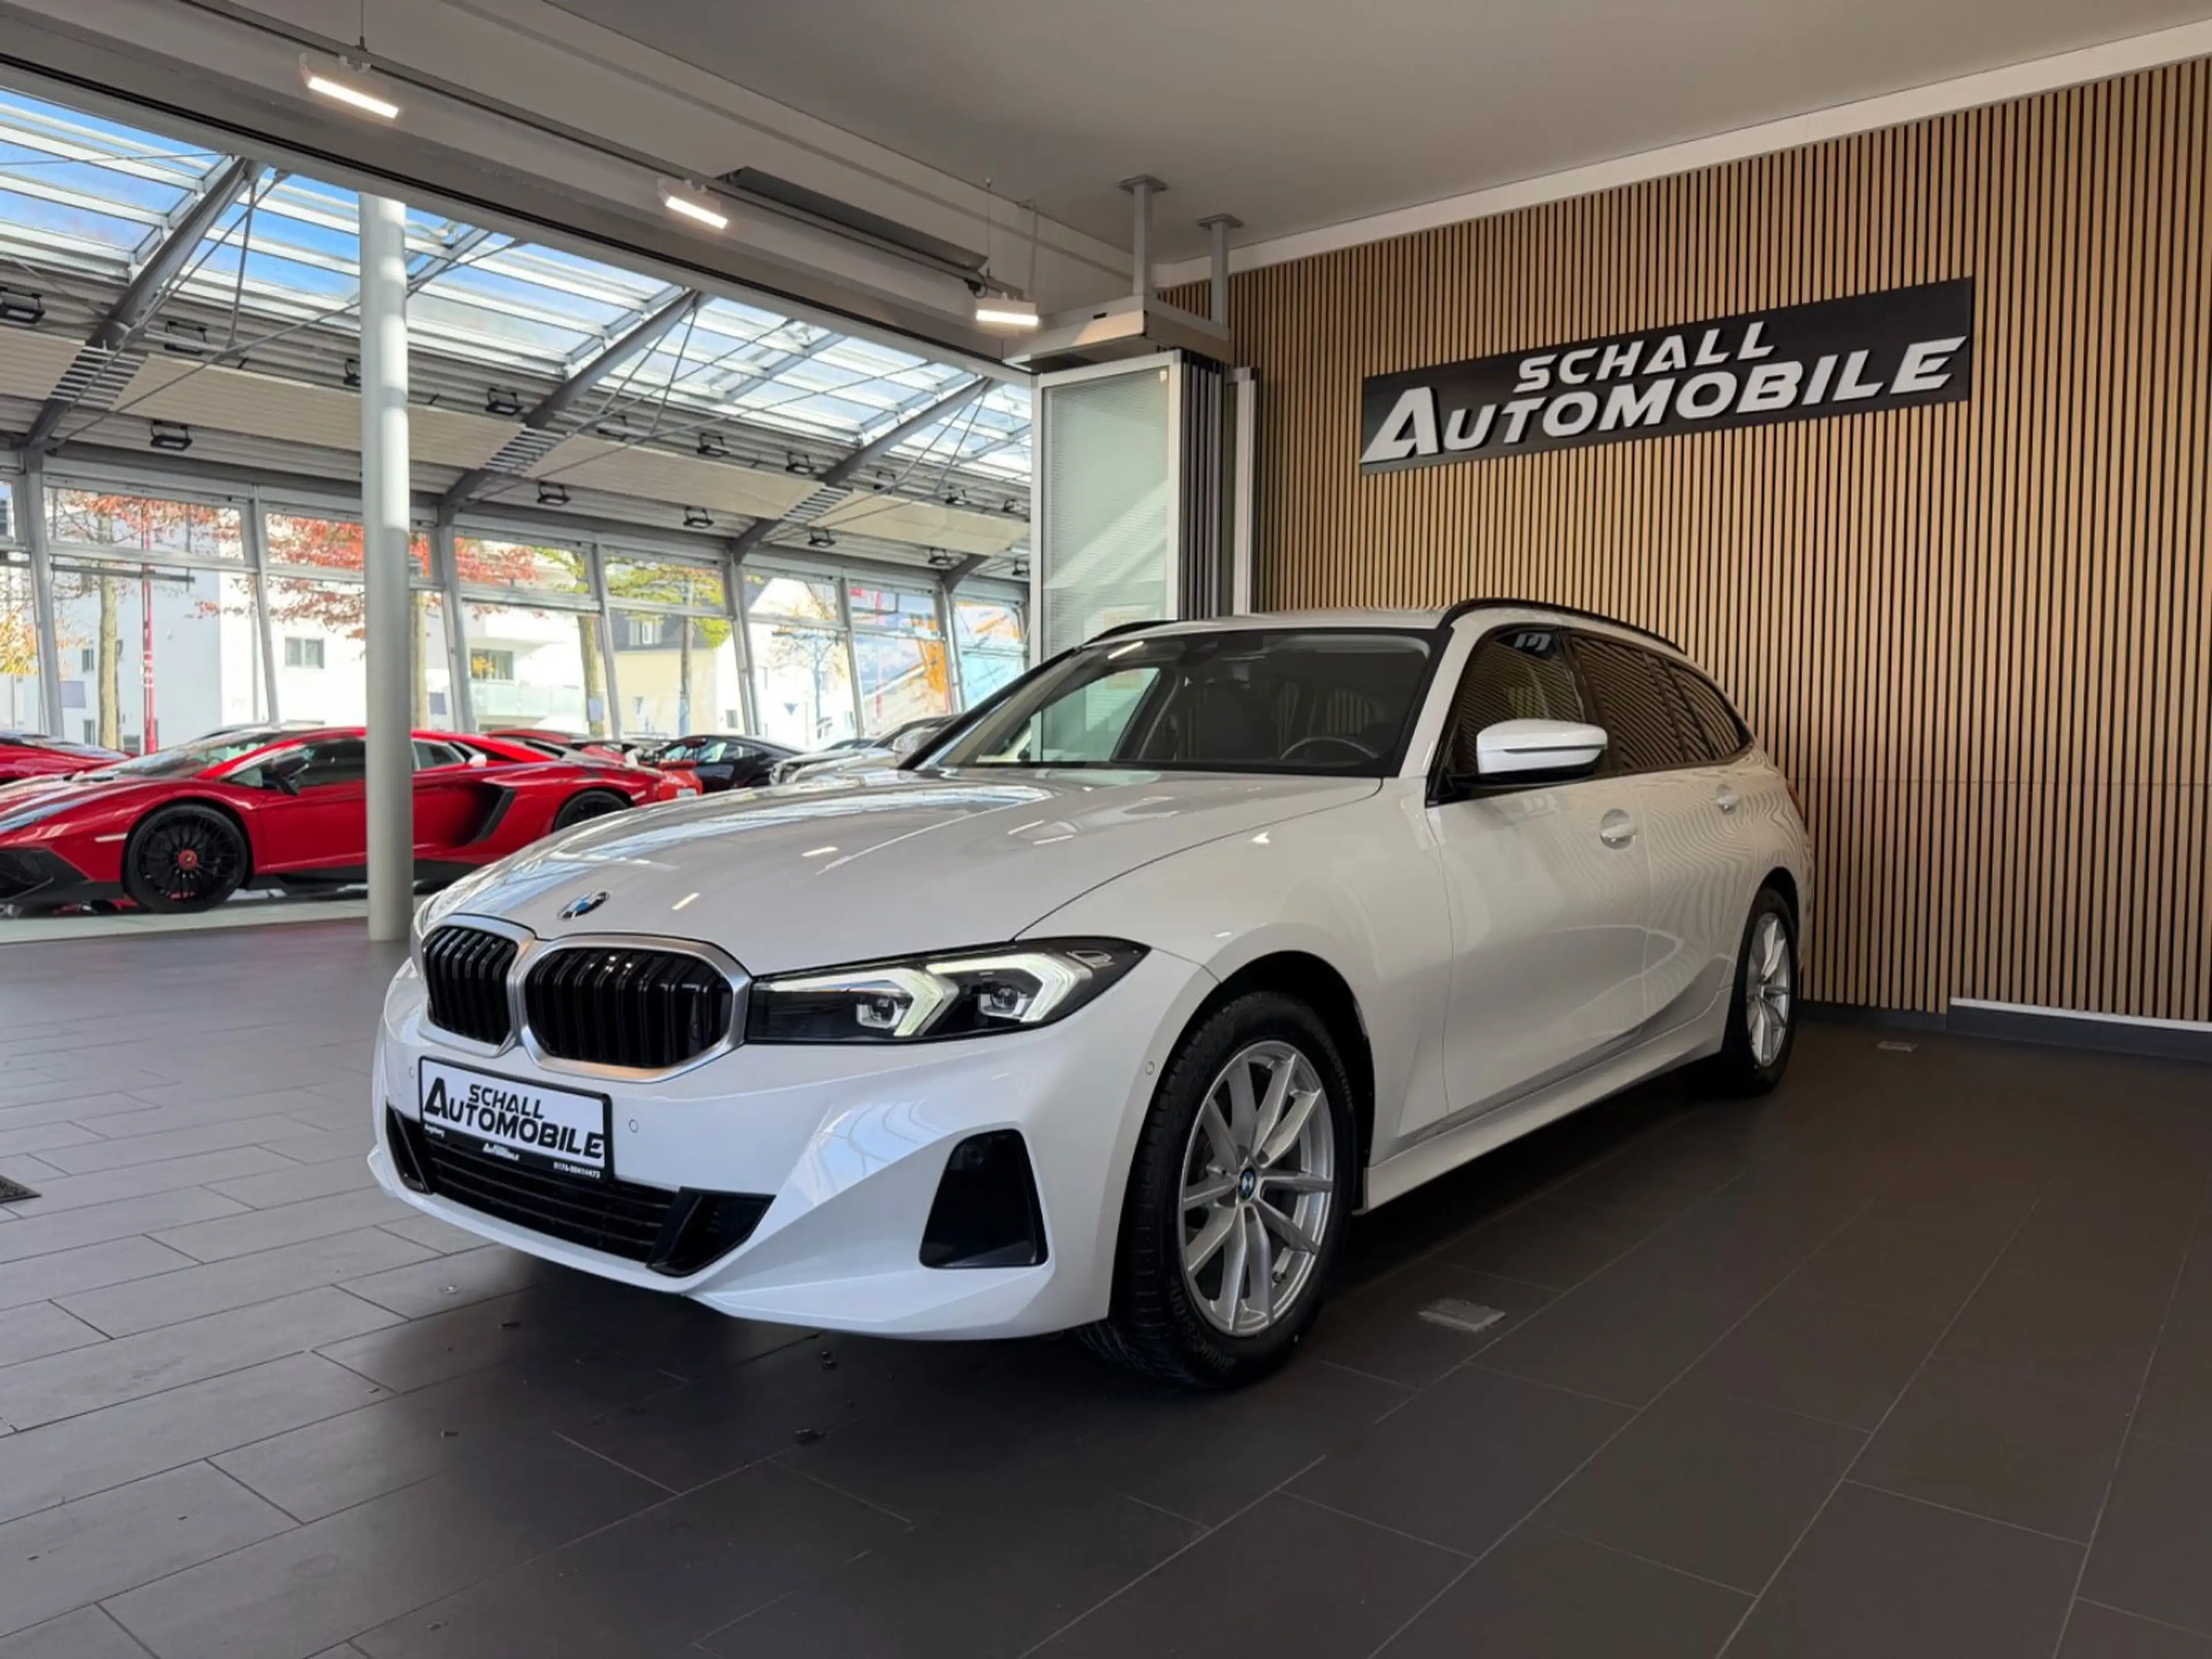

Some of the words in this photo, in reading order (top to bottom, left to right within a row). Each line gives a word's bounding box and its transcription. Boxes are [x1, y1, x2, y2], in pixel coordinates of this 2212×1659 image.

[1513, 320, 1774, 393] SCHALL
[1360, 336, 1967, 463] AUTOMOBILE
[424, 1077, 604, 1159] AUTOMOBILE
[468, 1084, 544, 1119] SCHALL
